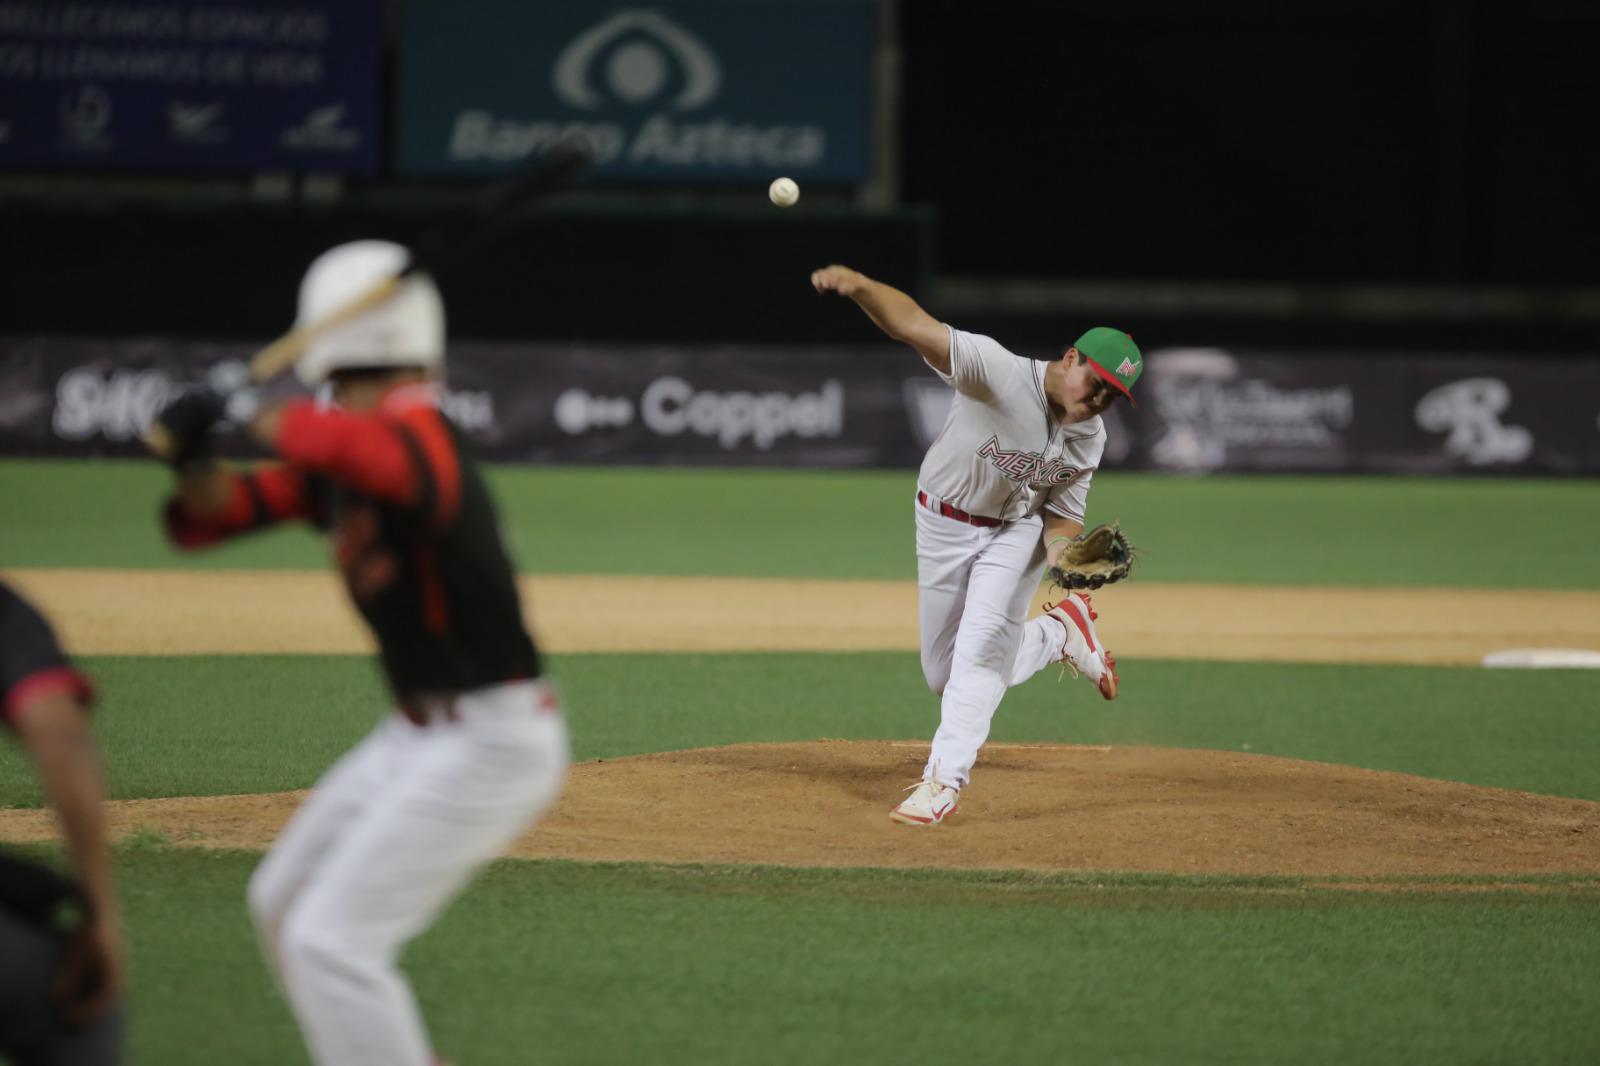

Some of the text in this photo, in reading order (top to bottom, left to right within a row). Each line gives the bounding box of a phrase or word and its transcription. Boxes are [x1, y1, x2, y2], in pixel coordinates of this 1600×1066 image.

[41, 46, 200, 82] LLENAMOS
[206, 49, 246, 85] DE
[253, 52, 326, 85] VIDA
[628, 115, 825, 165] Azteca
[643, 377, 843, 448] Coppel
